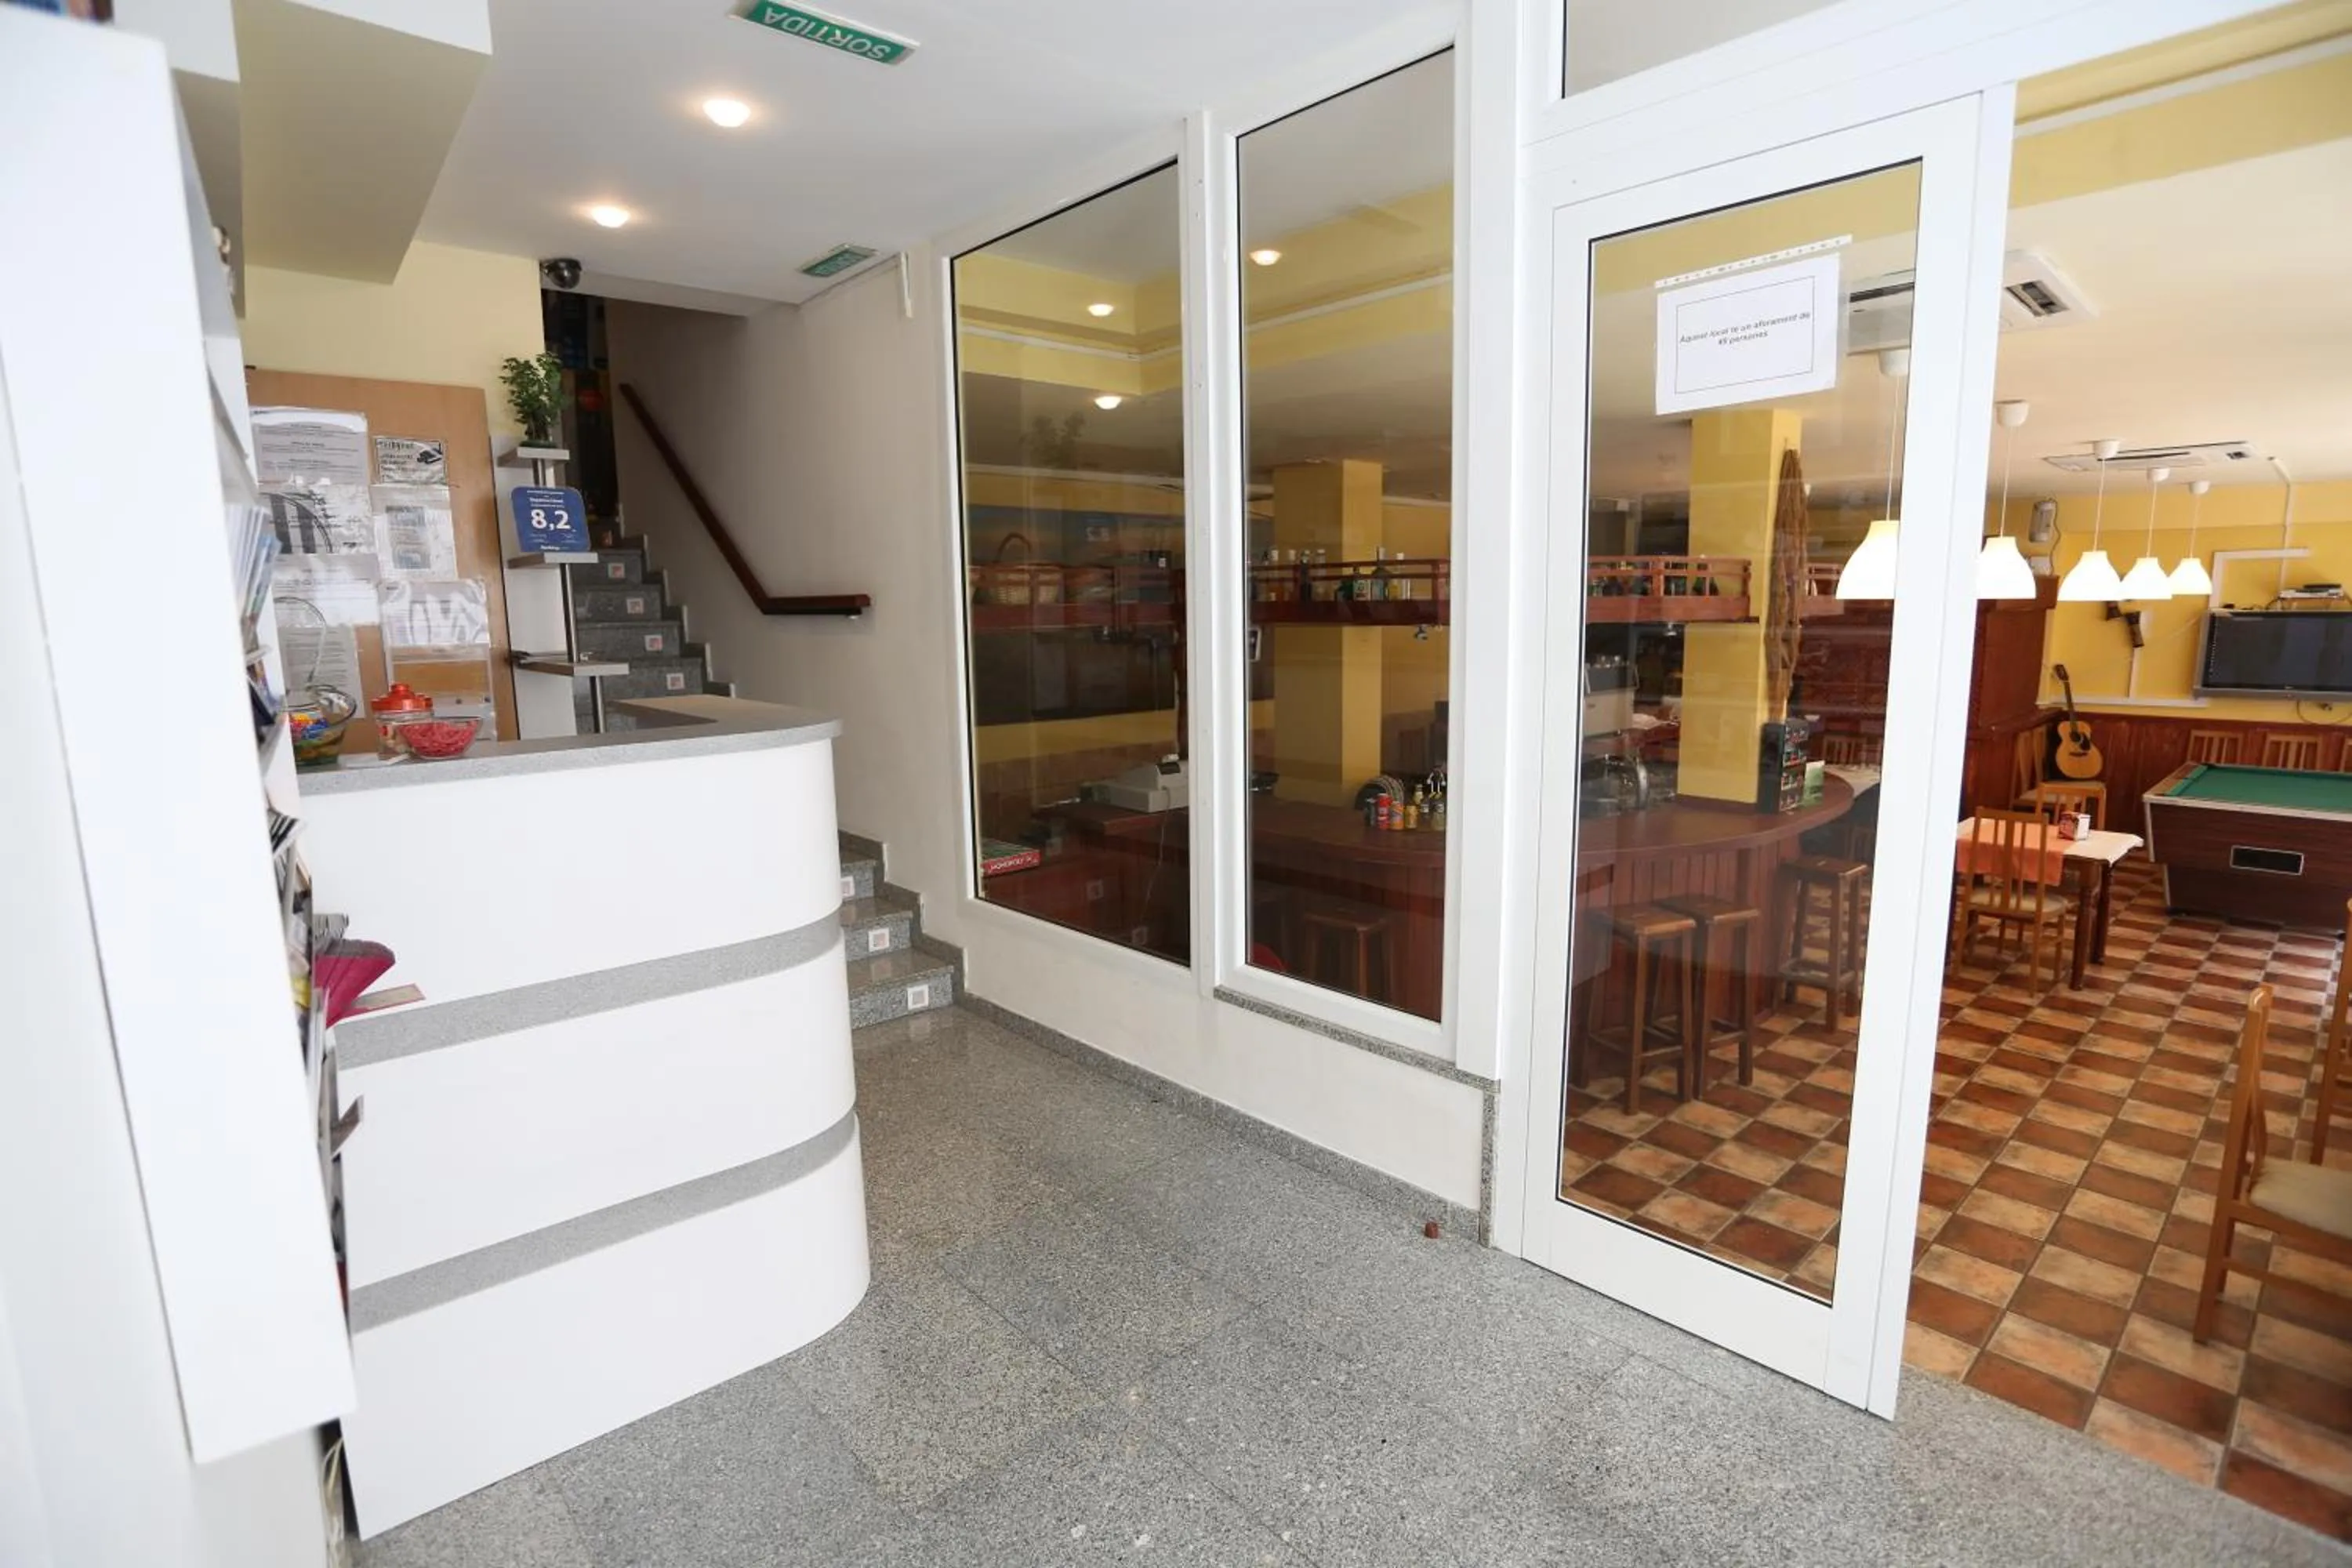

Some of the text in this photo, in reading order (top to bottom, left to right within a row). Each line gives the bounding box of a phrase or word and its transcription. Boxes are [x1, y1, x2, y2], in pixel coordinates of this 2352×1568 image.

[762, 6, 891, 60] SORTIDA
[1753, 314, 1797, 328] aforament
[1729, 331, 1768, 344] persones
[531, 508, 571, 532] 8,2
